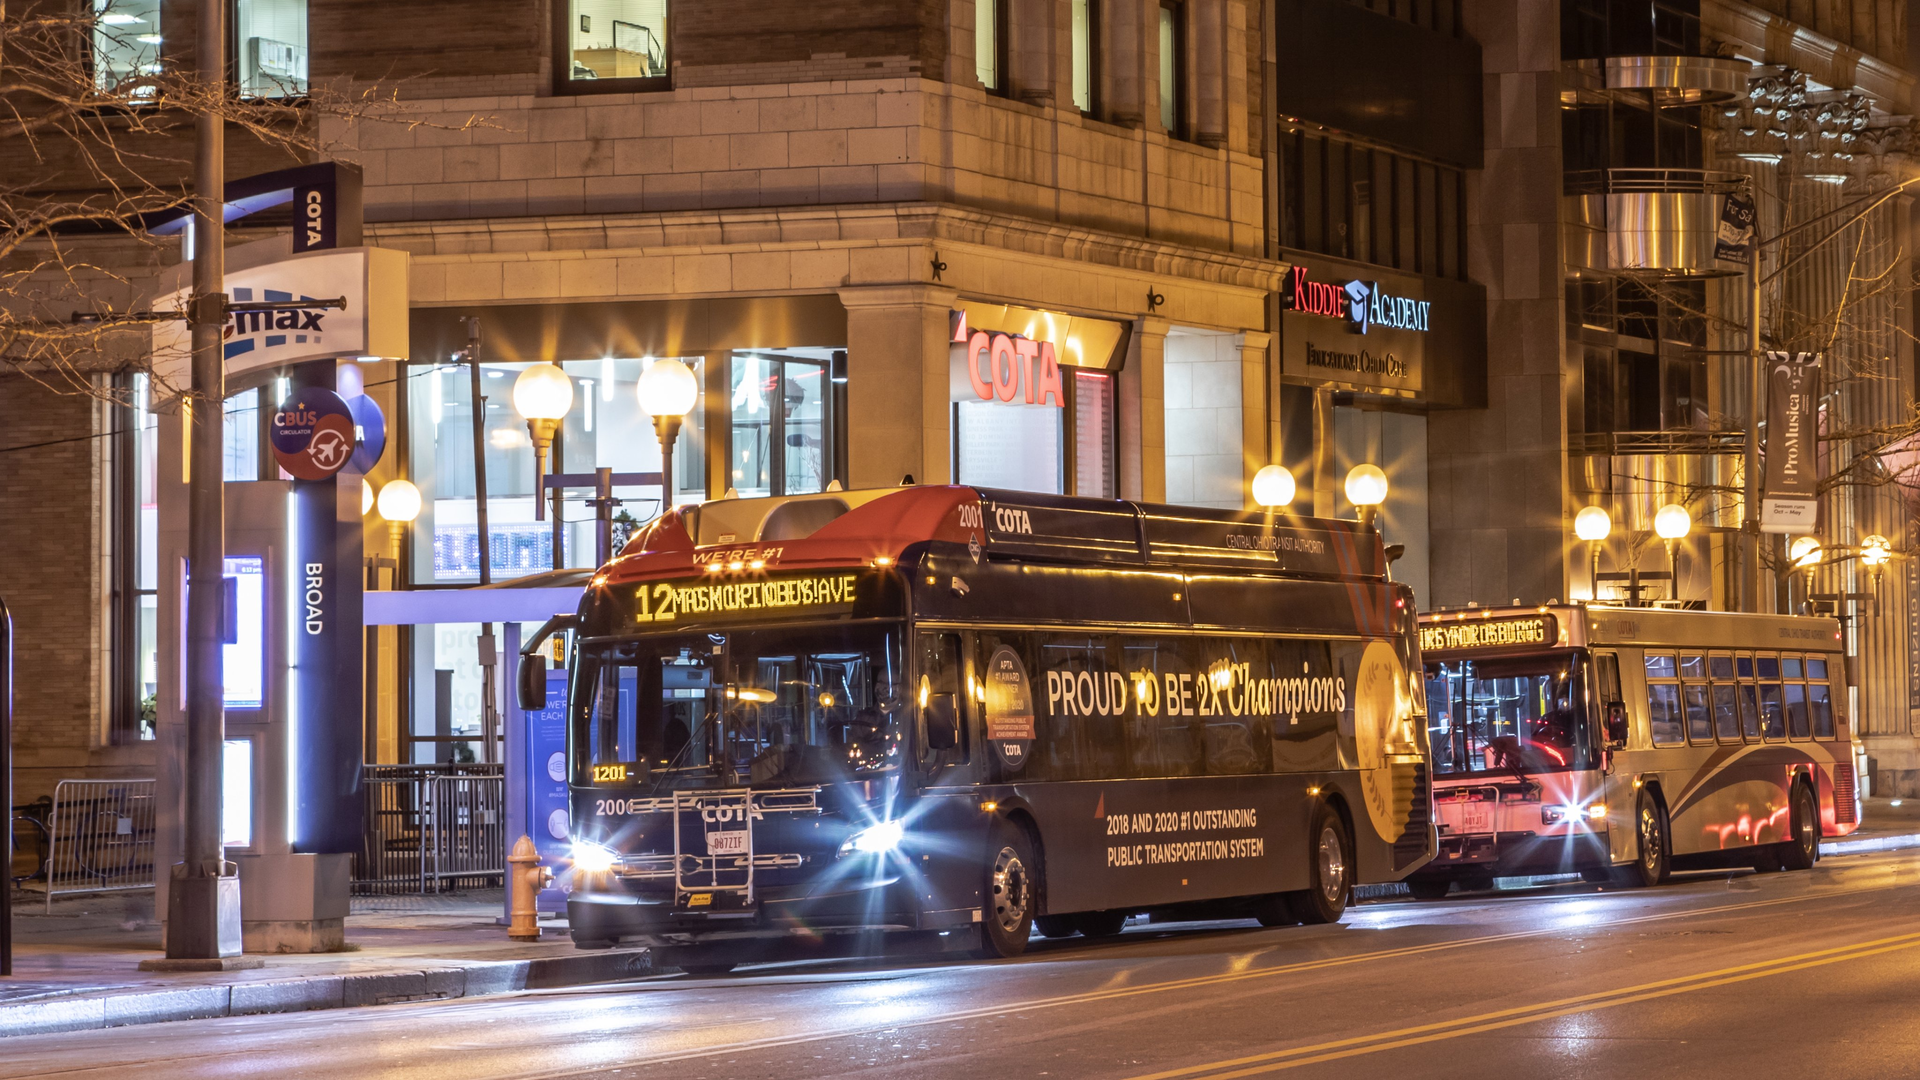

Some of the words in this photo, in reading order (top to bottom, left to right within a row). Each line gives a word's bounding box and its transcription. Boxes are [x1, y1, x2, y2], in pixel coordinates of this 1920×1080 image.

[307, 191, 321, 247] COTA
[1293, 266, 1345, 318] KIDDIE
[1369, 281, 1430, 331] ACADEMY
[967, 331, 1065, 408] COTA
[274, 411, 317, 427] CBUS
[1784, 394, 1800, 475] ProMusica
[958, 504, 984, 529] 2001
[996, 508, 1033, 535] COTA
[692, 549, 757, 565] WE'RE
[761, 547, 783, 559] #1
[1225, 534, 1253, 549] CENTRAL
[1252, 536, 1270, 550] OHIO
[1269, 536, 1293, 551] TRANSIT
[1294, 538, 1325, 554] AUTHORITY
[306, 563, 323, 635] BROAD
[635, 583, 676, 623] 12
[1000, 660, 1014, 670] APTA
[1001, 672, 1020, 682] AWARD
[1047, 670, 1127, 717] PROUD
[1130, 672, 1160, 717] TO
[1164, 672, 1194, 716] BE
[1227, 661, 1346, 725] Champions
[541, 712, 563, 721] EACH
[1005, 744, 1022, 756] COTA
[593, 765, 626, 783] 1201
[596, 799, 626, 816] 200
[1106, 814, 1130, 836] 2018
[1131, 813, 1153, 834] AND
[1154, 811, 1179, 833] 2020
[1180, 811, 1191, 831] #1
[1192, 808, 1257, 830] OUTSTANDING
[1107, 845, 1143, 868] PUBLIC
[1144, 840, 1228, 864] TRANSPORTATION
[1230, 837, 1264, 859] SYSTEM
